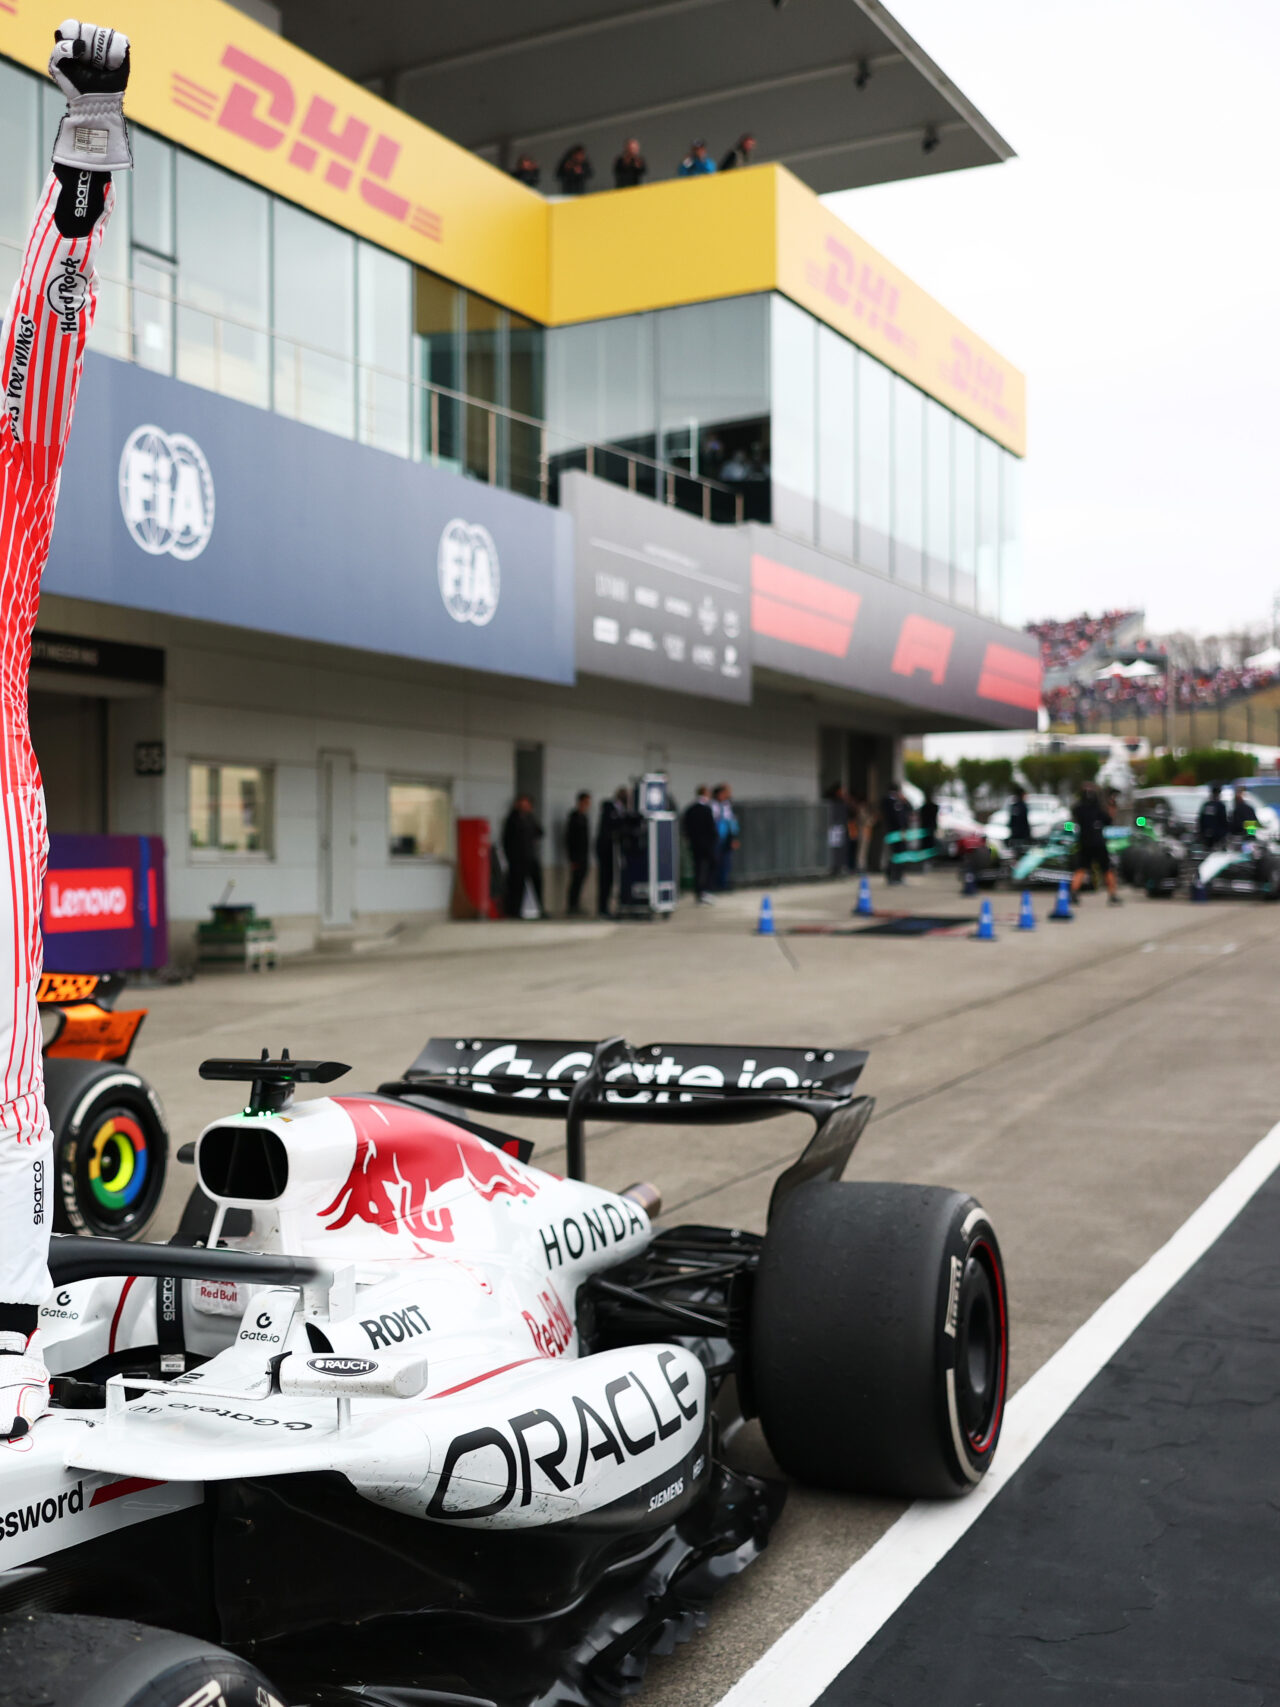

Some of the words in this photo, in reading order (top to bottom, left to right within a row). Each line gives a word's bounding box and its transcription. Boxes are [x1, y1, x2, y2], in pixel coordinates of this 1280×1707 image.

[217, 43, 412, 224] DHL
[75, 171, 92, 218] sparc
[59, 257, 80, 294] Rock
[825, 234, 901, 346] DHL
[61, 295, 77, 333] Hard
[15, 315, 35, 368] WINGS
[7, 366, 24, 399] YOU
[49, 882, 128, 918] Lenovo
[33, 1160, 44, 1225] sparco
[539, 1200, 644, 1271] HONDA
[201, 1286, 219, 1298] Red
[220, 1288, 238, 1302] Bull
[41, 1307, 79, 1320] Gate.io
[359, 1305, 431, 1350] ROKT
[239, 1329, 280, 1343] Gate.io
[325, 1360, 370, 1370] RAUCH
[425, 1350, 698, 1520] ORACLE
[648, 1477, 684, 1512] SIEMENS
